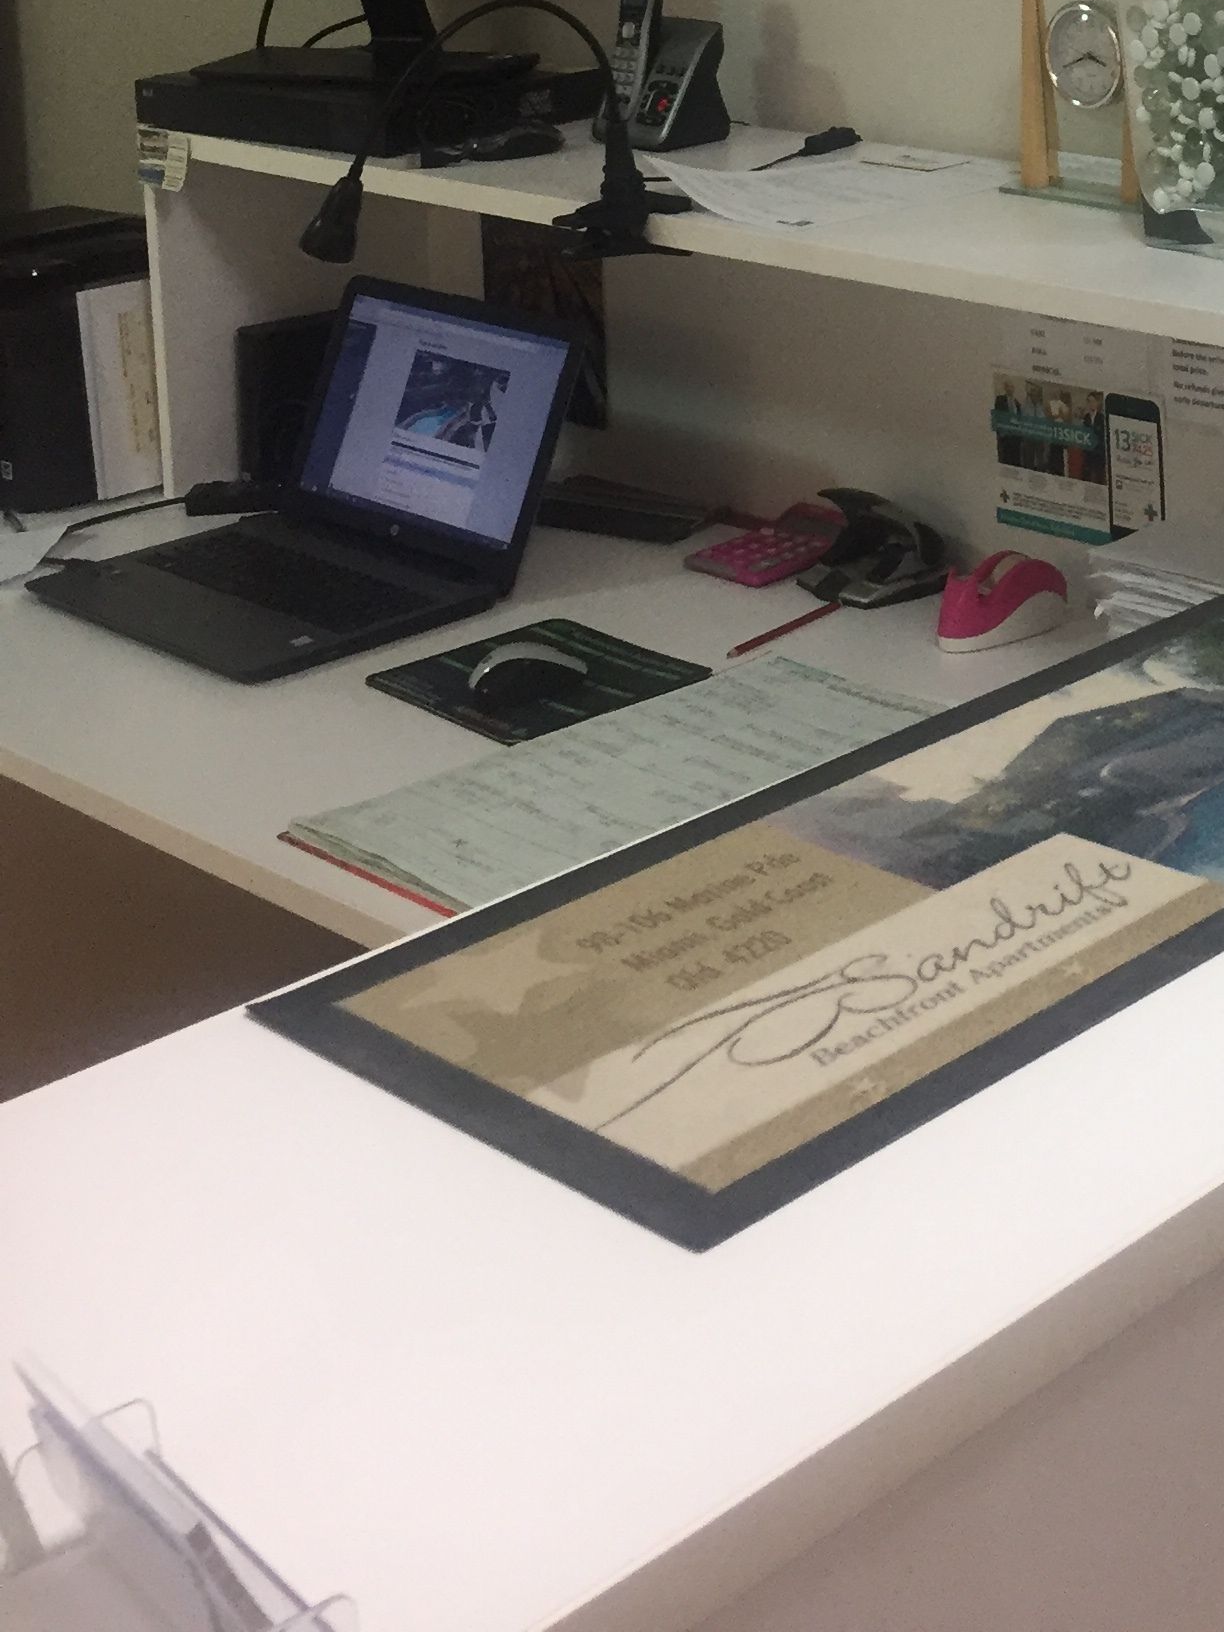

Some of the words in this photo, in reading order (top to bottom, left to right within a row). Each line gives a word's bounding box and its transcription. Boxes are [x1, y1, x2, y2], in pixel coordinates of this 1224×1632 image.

[1053, 426, 1092, 446] 13SICK
[1114, 428, 1131, 451] 13
[810, 982, 966, 1067] Beachfront
[968, 898, 1130, 987] Apartments
